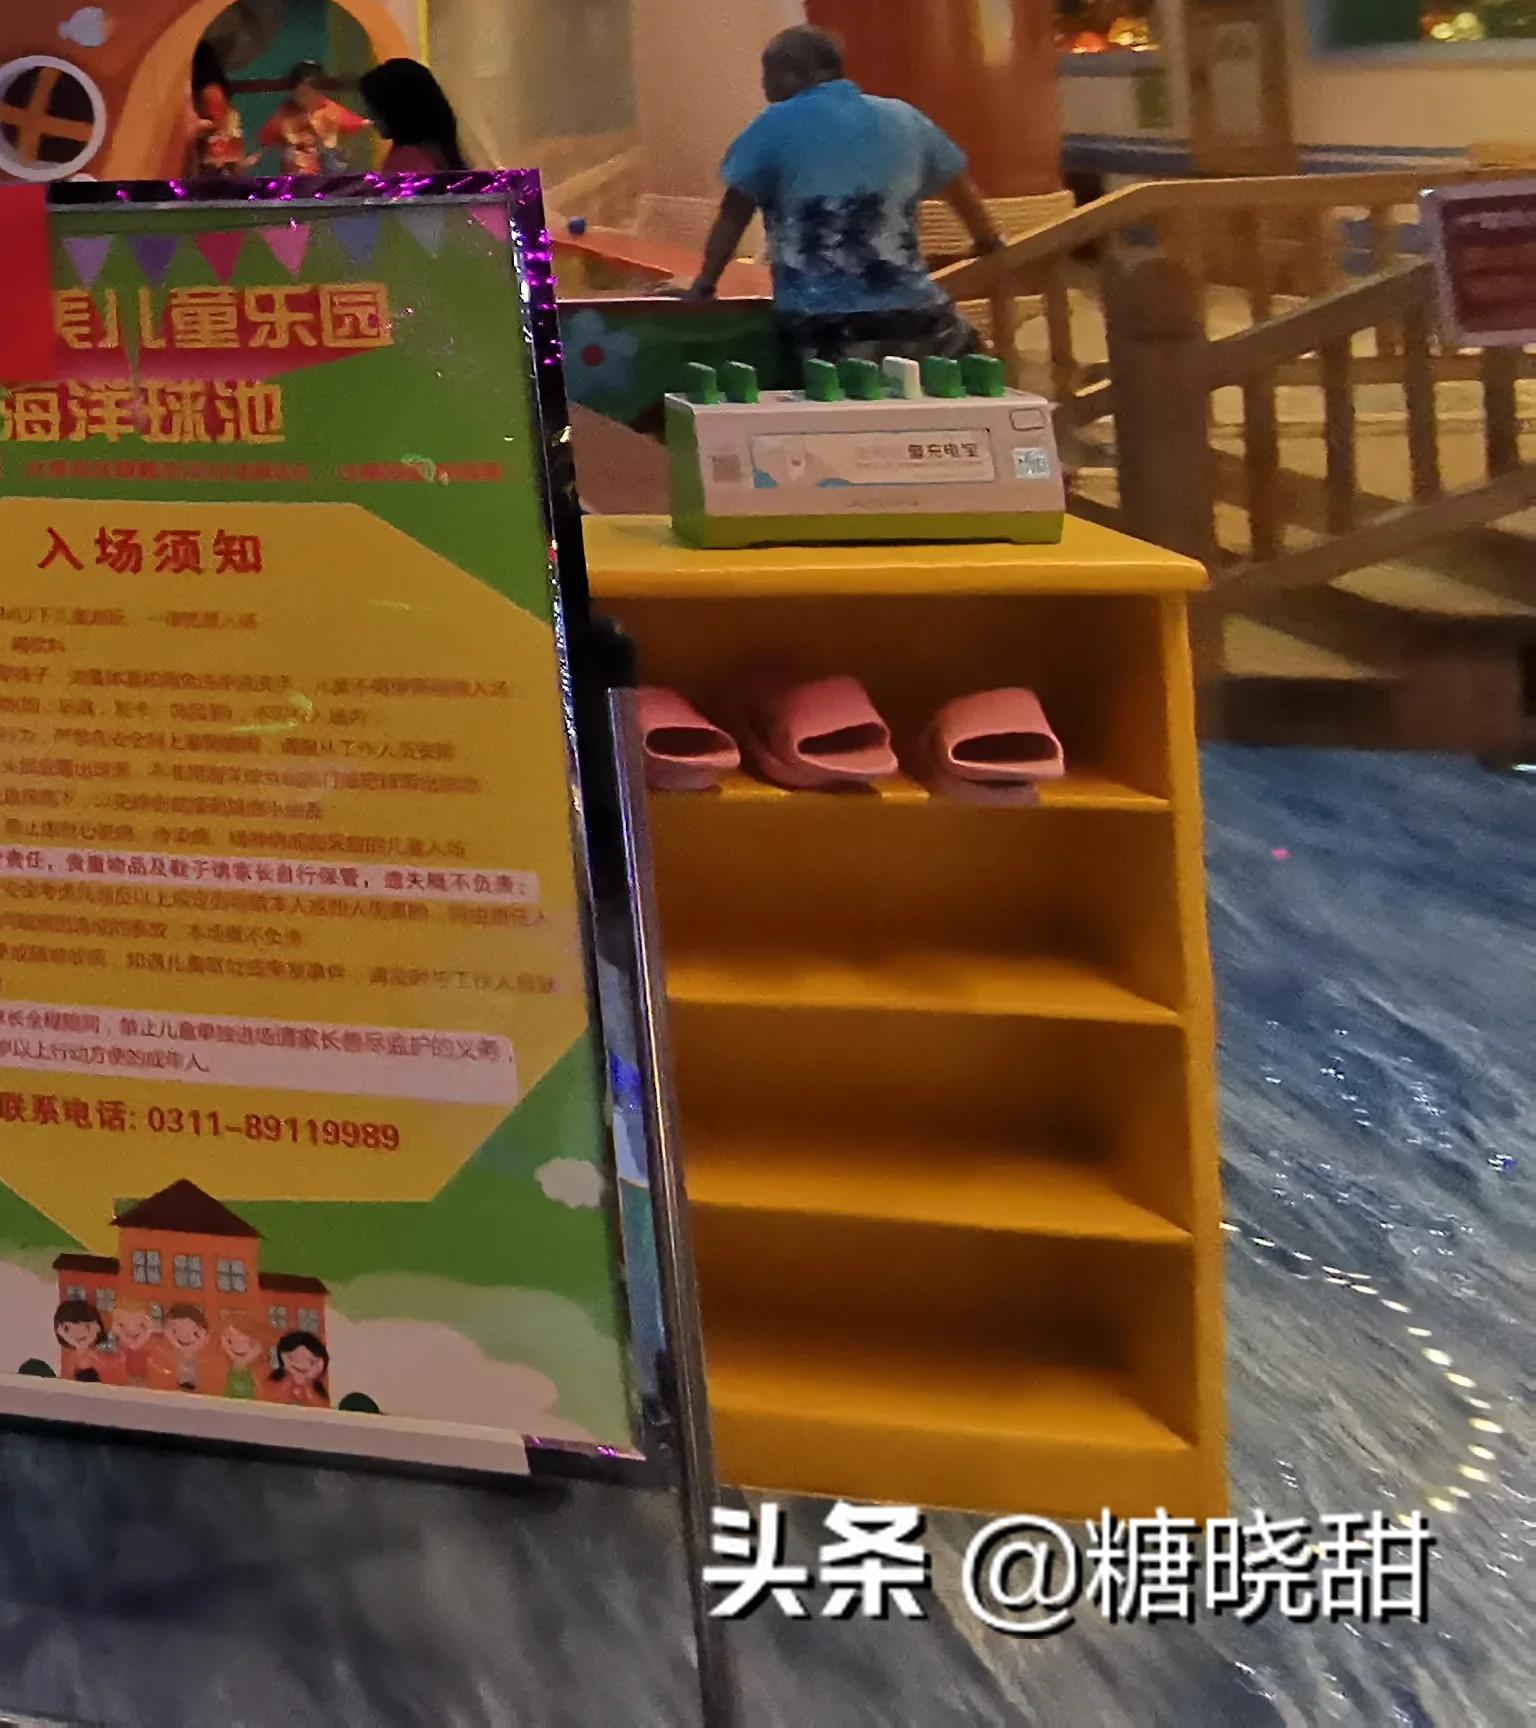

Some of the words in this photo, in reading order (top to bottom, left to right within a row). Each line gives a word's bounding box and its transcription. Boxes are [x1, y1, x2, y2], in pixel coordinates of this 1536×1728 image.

[36, 525, 264, 575] 入场须知
[147, 1105, 400, 1152] 0311-89119989
